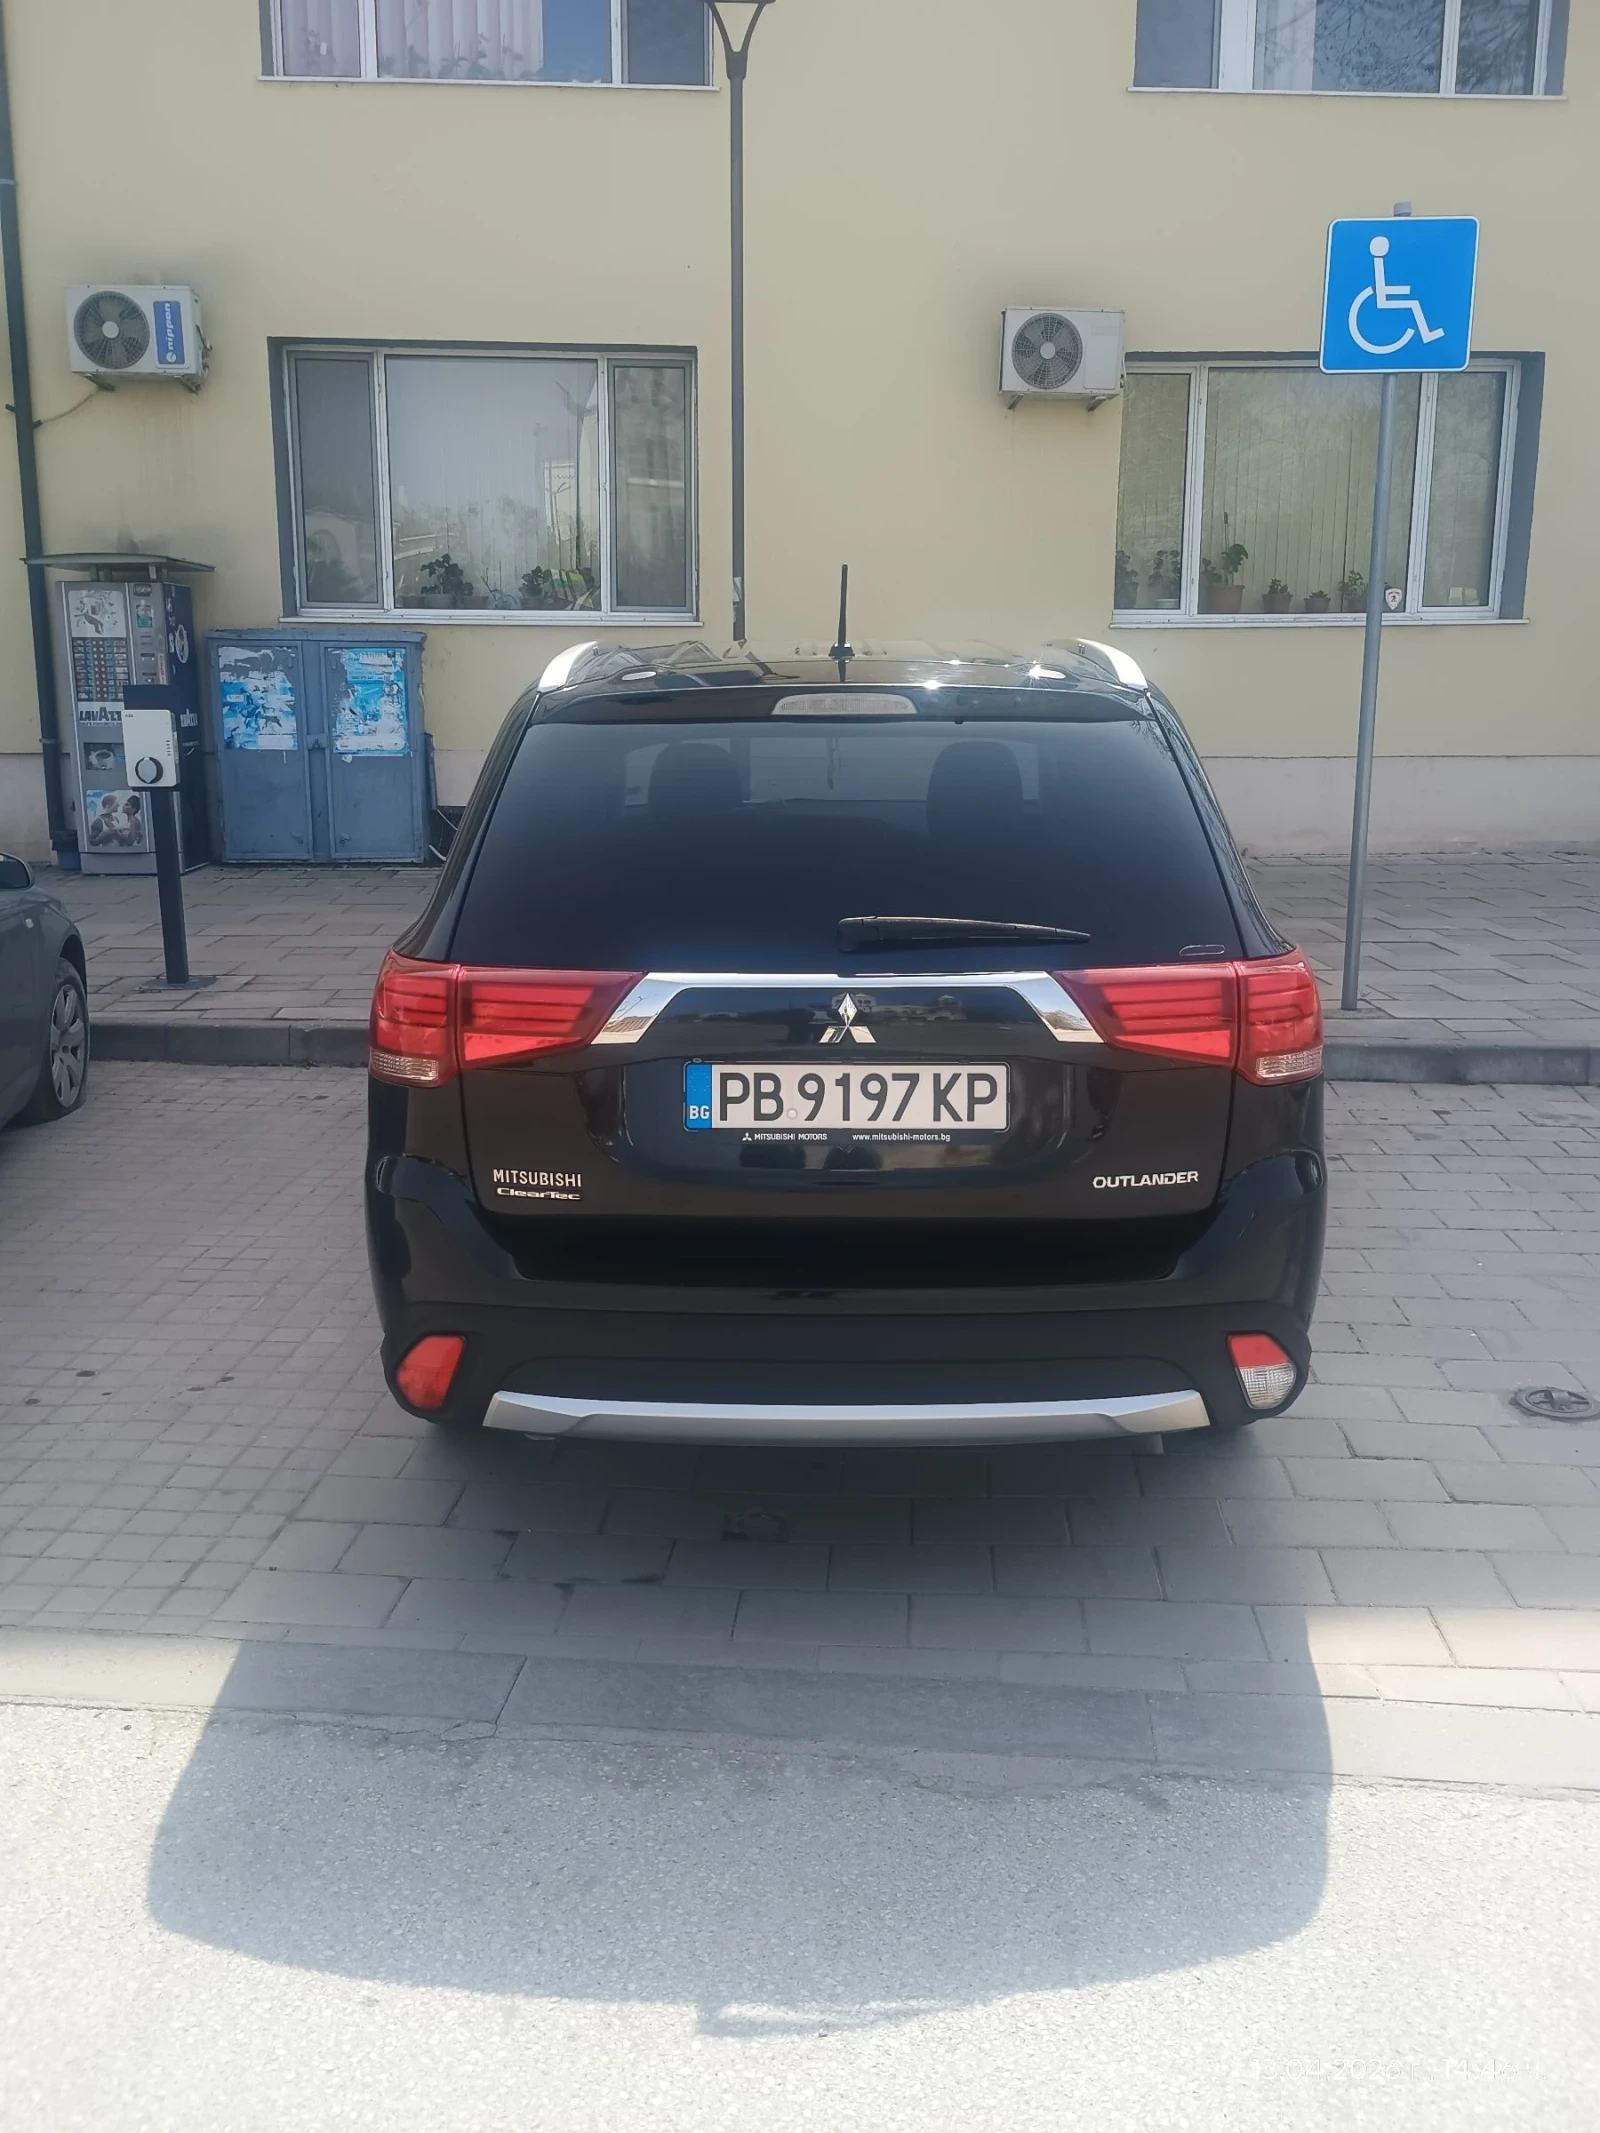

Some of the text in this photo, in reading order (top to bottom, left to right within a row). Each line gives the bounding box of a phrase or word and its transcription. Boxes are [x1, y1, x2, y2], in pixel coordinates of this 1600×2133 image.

[79, 706, 122, 722] LAVAZZ
[719, 1072, 998, 1122] PB 9197 KP
[689, 1105, 710, 1120] BG
[754, 1133, 828, 1141] MITSUBISHI MOTORS
[852, 1132, 951, 1143] www.mitsubishi-motors.bg
[493, 1169, 582, 1187] MITSUBISHI
[1092, 1170, 1199, 1189] OUTLANDER
[497, 1187, 581, 1200] ClearTec
